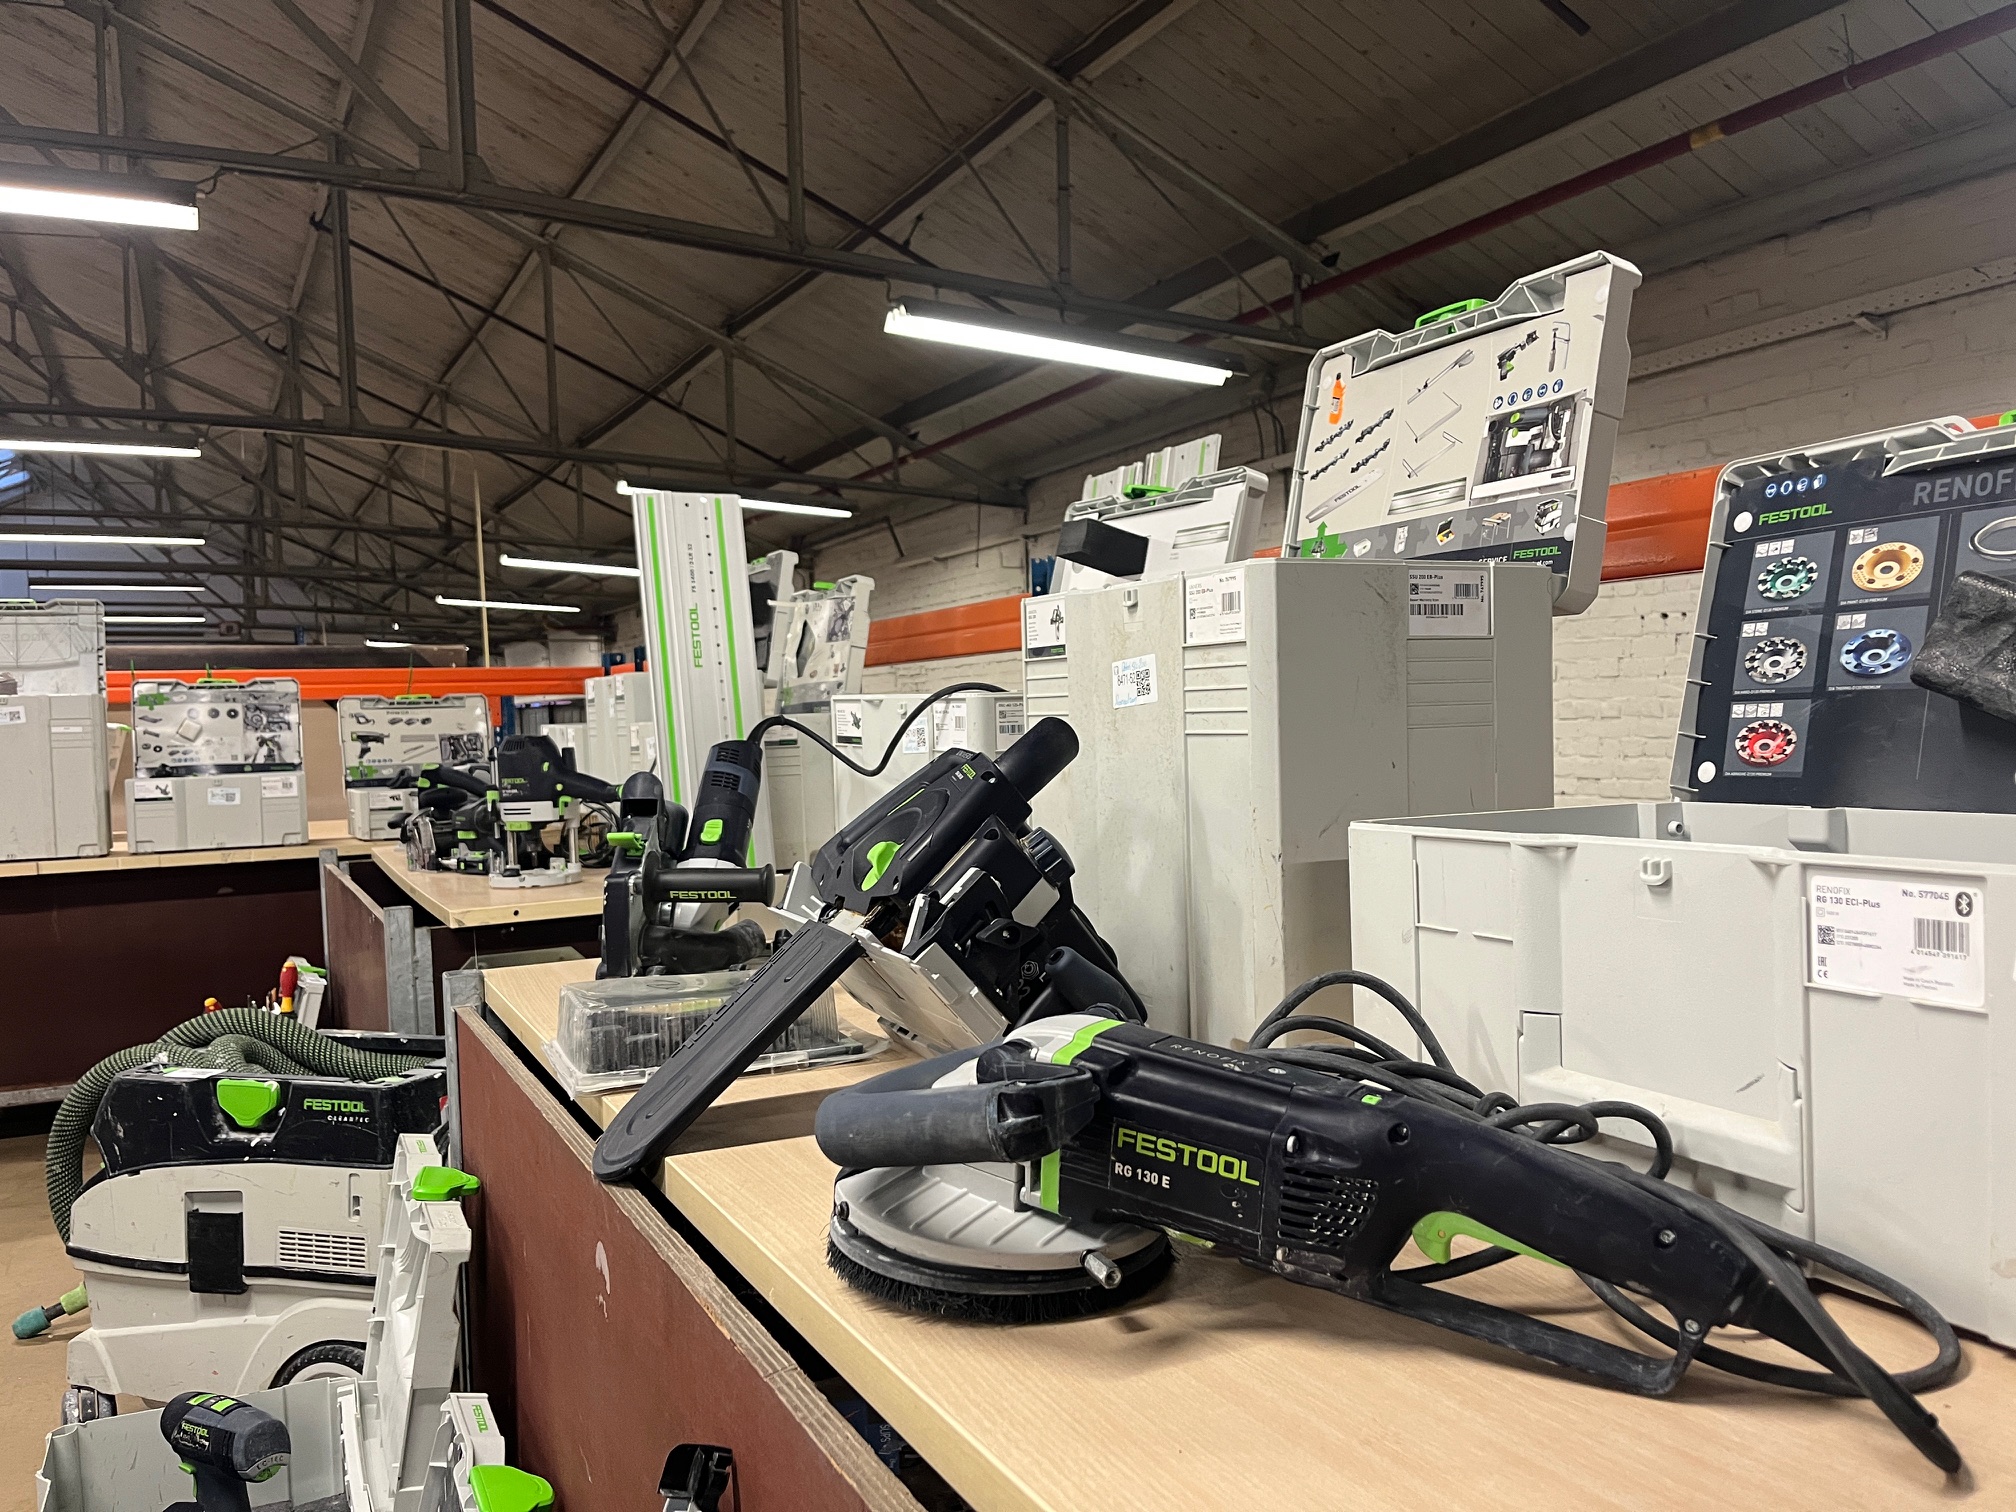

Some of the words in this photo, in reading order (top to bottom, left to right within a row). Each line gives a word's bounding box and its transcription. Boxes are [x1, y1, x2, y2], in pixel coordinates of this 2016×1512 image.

[1913, 468, 2016, 505] RENOF
[1758, 504, 1832, 525] FESTOOL
[1513, 546, 1562, 559] FESTOOL
[689, 602, 703, 668] FESTOOL
[670, 890, 737, 899] FESTOOL
[1816, 885, 1850, 895] RENOFIX
[1902, 889, 1916, 898] No.
[1918, 890, 1950, 900] 577045
[1816, 895, 1827, 903] RG
[1830, 896, 1843, 905] 130
[1845, 898, 1881, 908] ECI-Plus
[304, 1098, 370, 1112] FESTOOL
[1117, 1127, 1260, 1186] FESTOOL
[1114, 1162, 1132, 1177] RG
[1136, 1168, 1159, 1185] 130
[1162, 1176, 1171, 1189] E
[182, 1422, 209, 1437] FESTOOL
